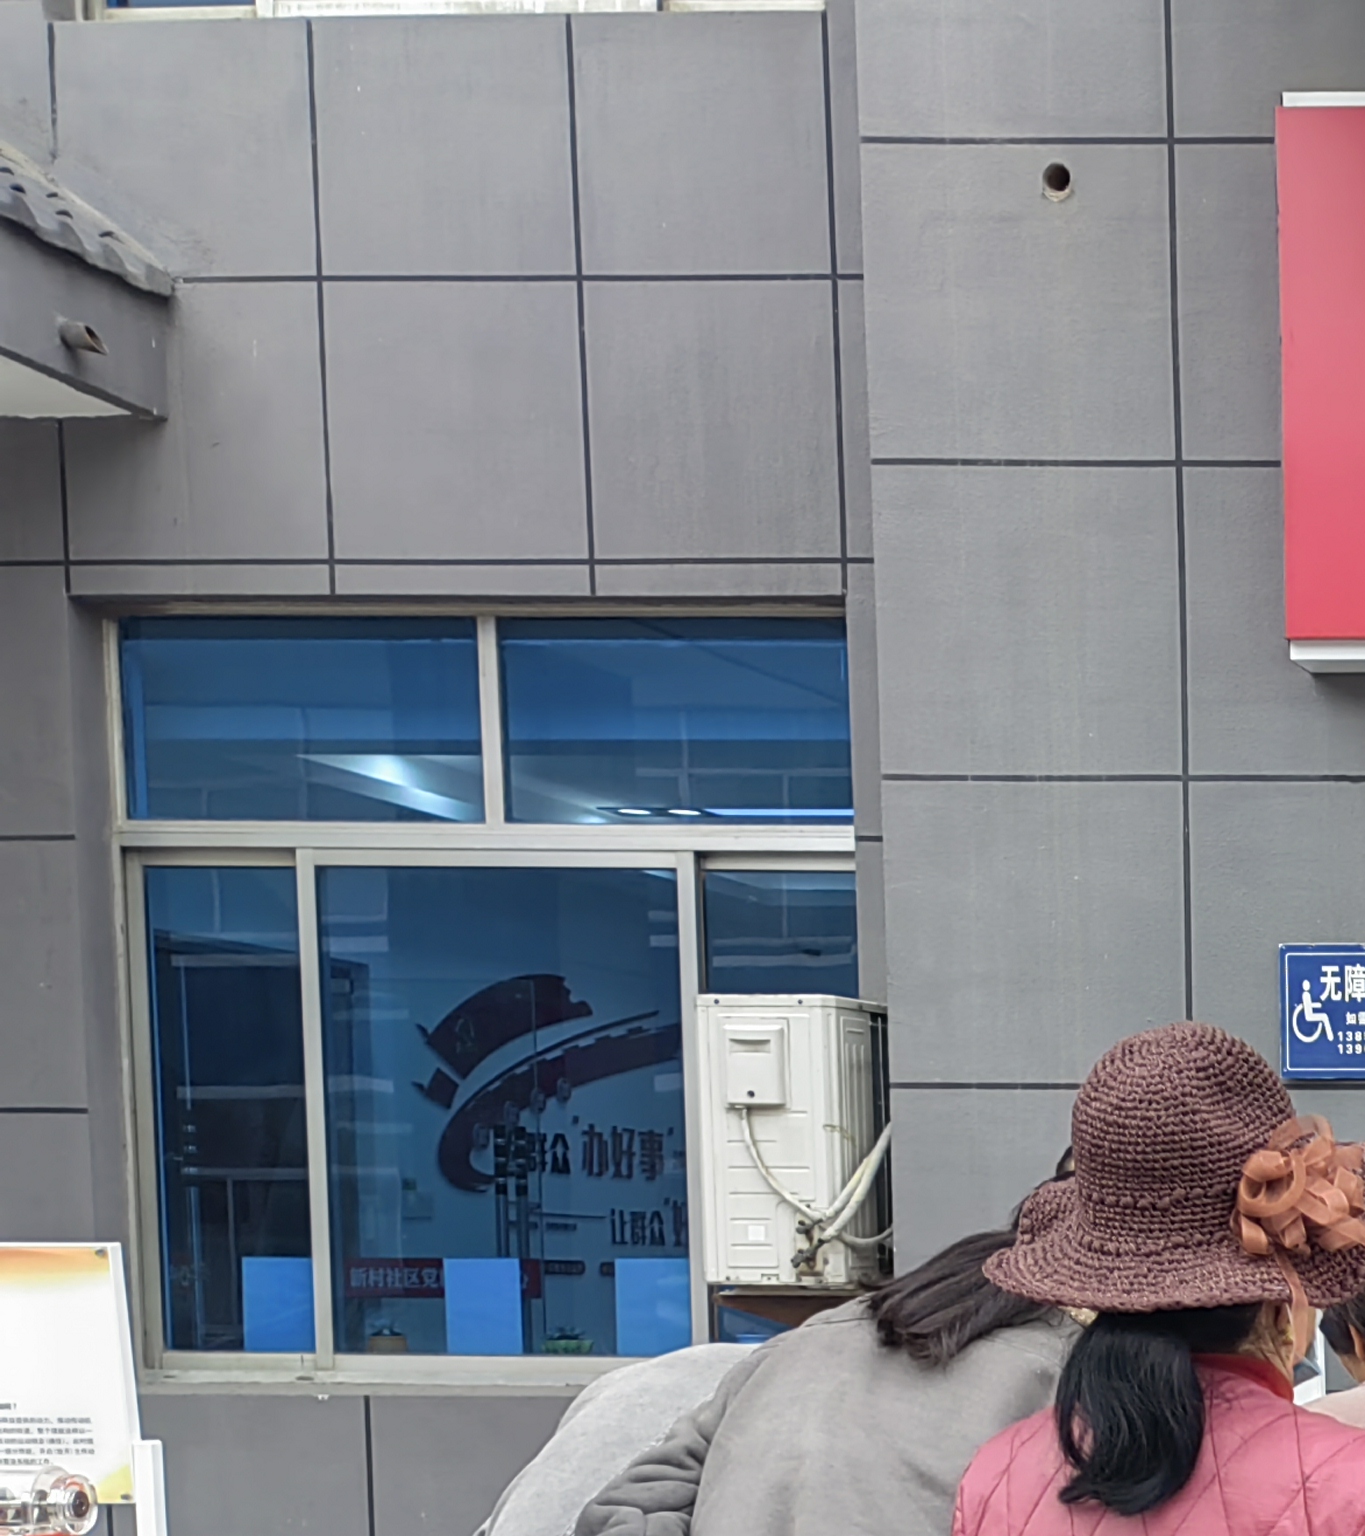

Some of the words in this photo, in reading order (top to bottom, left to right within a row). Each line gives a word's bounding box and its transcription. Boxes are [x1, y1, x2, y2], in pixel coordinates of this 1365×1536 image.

[350, 1265, 444, 1288] 新村社区党
